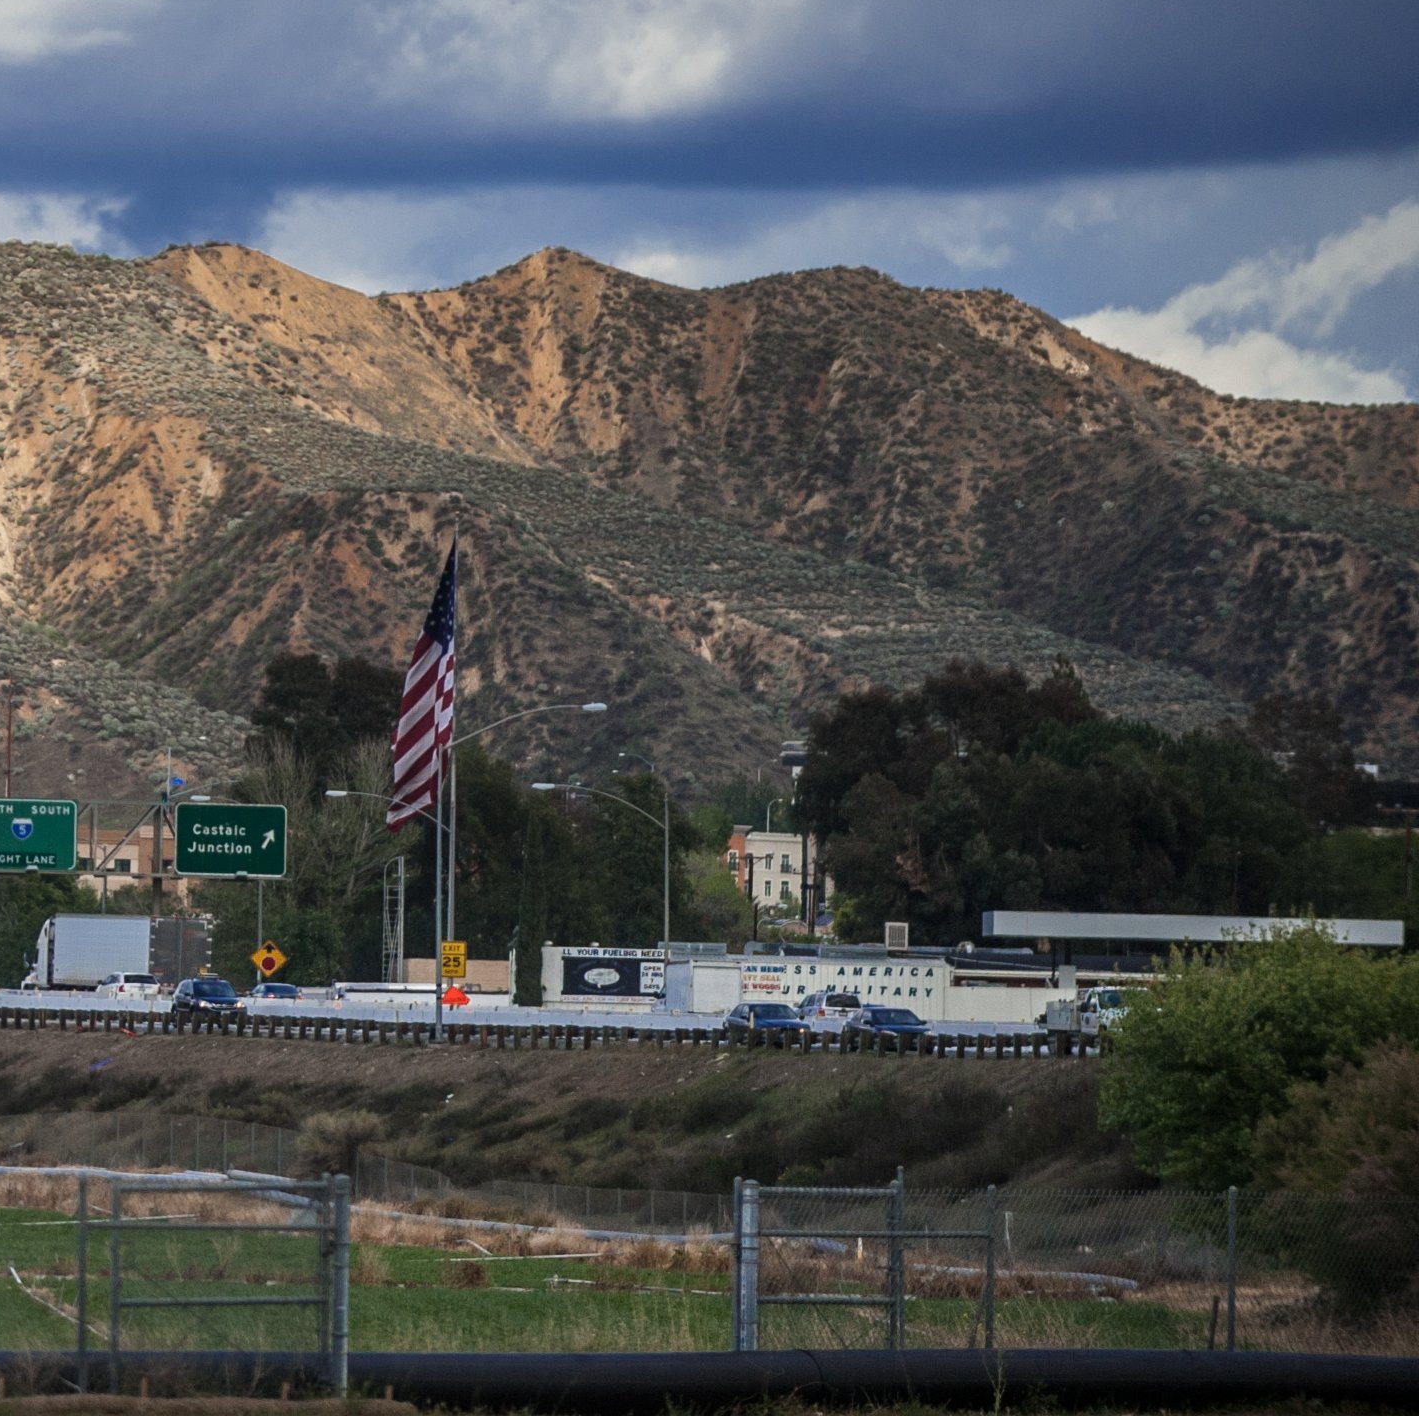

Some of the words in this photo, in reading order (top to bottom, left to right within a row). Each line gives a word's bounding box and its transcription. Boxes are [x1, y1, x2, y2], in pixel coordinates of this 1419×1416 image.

[31, 805, 70, 815] SOUTH
[18, 824, 26, 835] 5
[192, 823, 246, 836] Castaic
[187, 841, 252, 854] Junction
[26, 855, 55, 864] LANE
[603, 949, 637, 957] FUELING
[443, 956, 461, 968] 25
[837, 967, 934, 977] AMERICA
